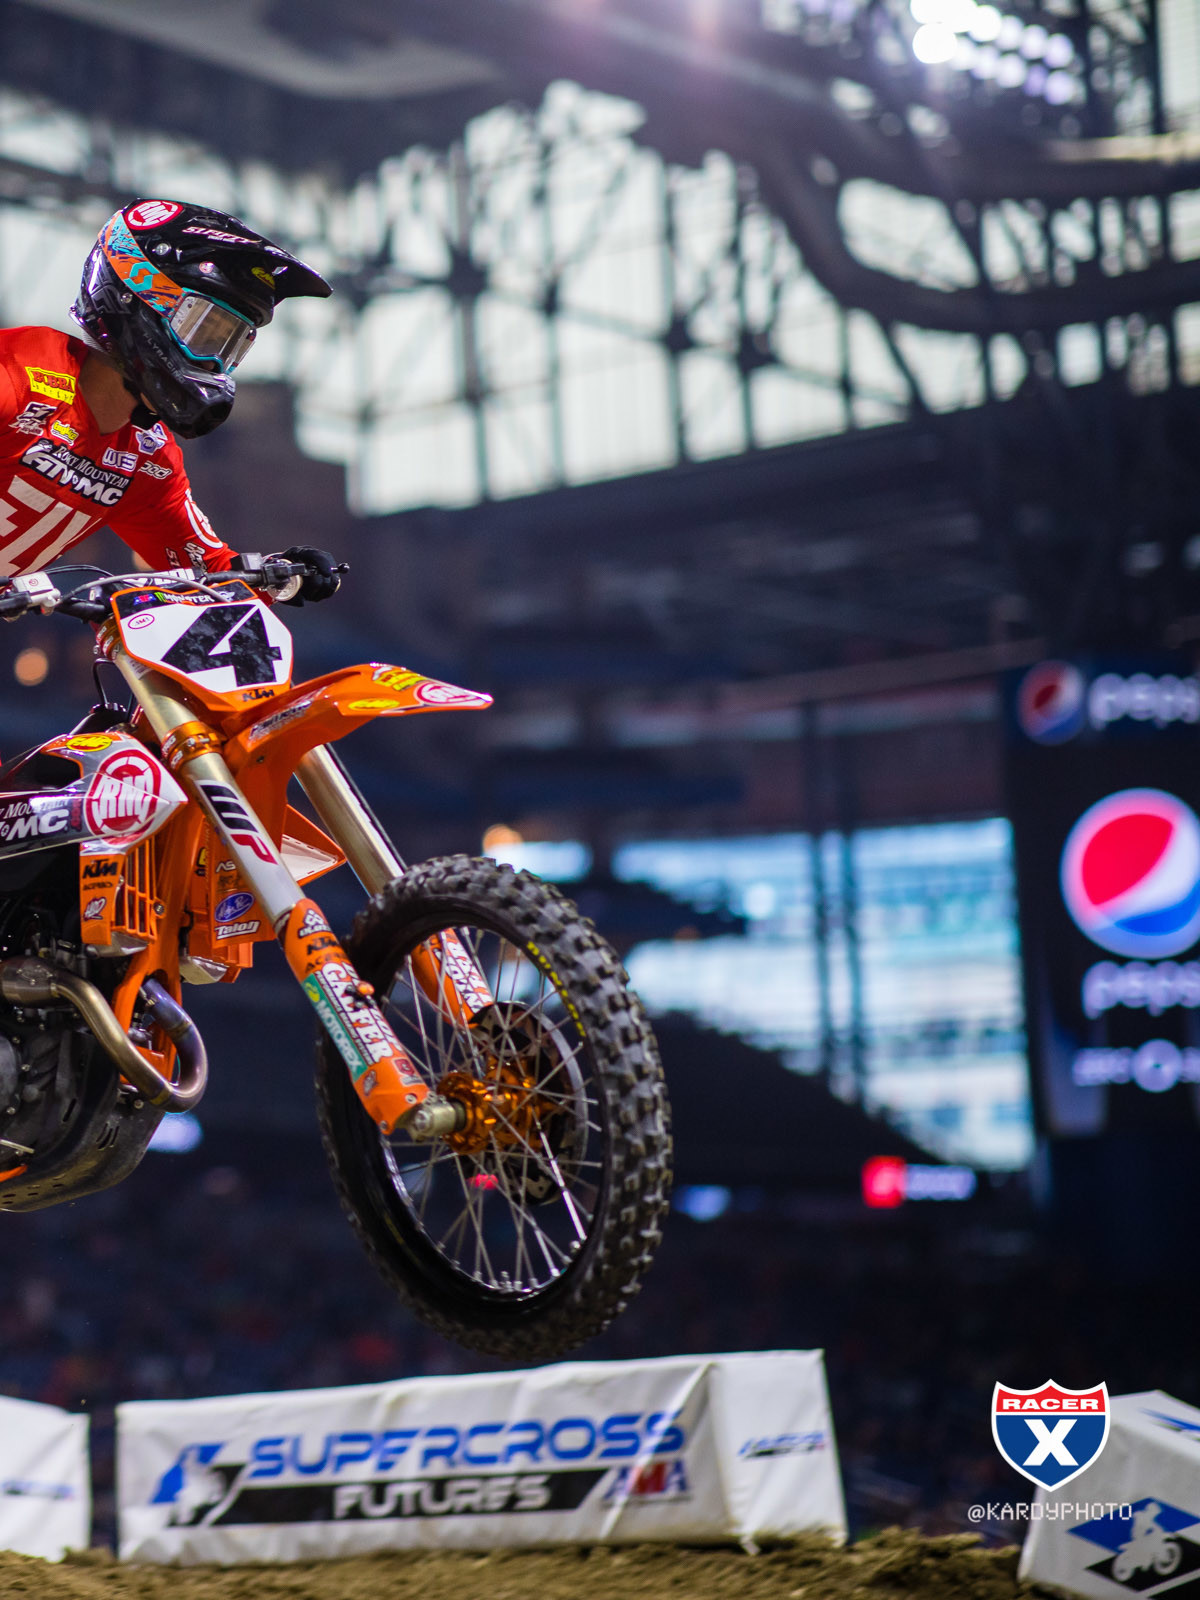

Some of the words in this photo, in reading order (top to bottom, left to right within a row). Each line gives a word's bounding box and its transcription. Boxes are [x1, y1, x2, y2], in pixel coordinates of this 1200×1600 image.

[160, 604, 283, 688] 4
[242, 688, 276, 703] KTM
[82, 858, 118, 879] KTM
[215, 920, 261, 937] Talon
[317, 1000, 362, 1076] MOTOREX
[249, 1408, 686, 1480] SUPERCROSS
[333, 1473, 551, 1520] FUTURES
